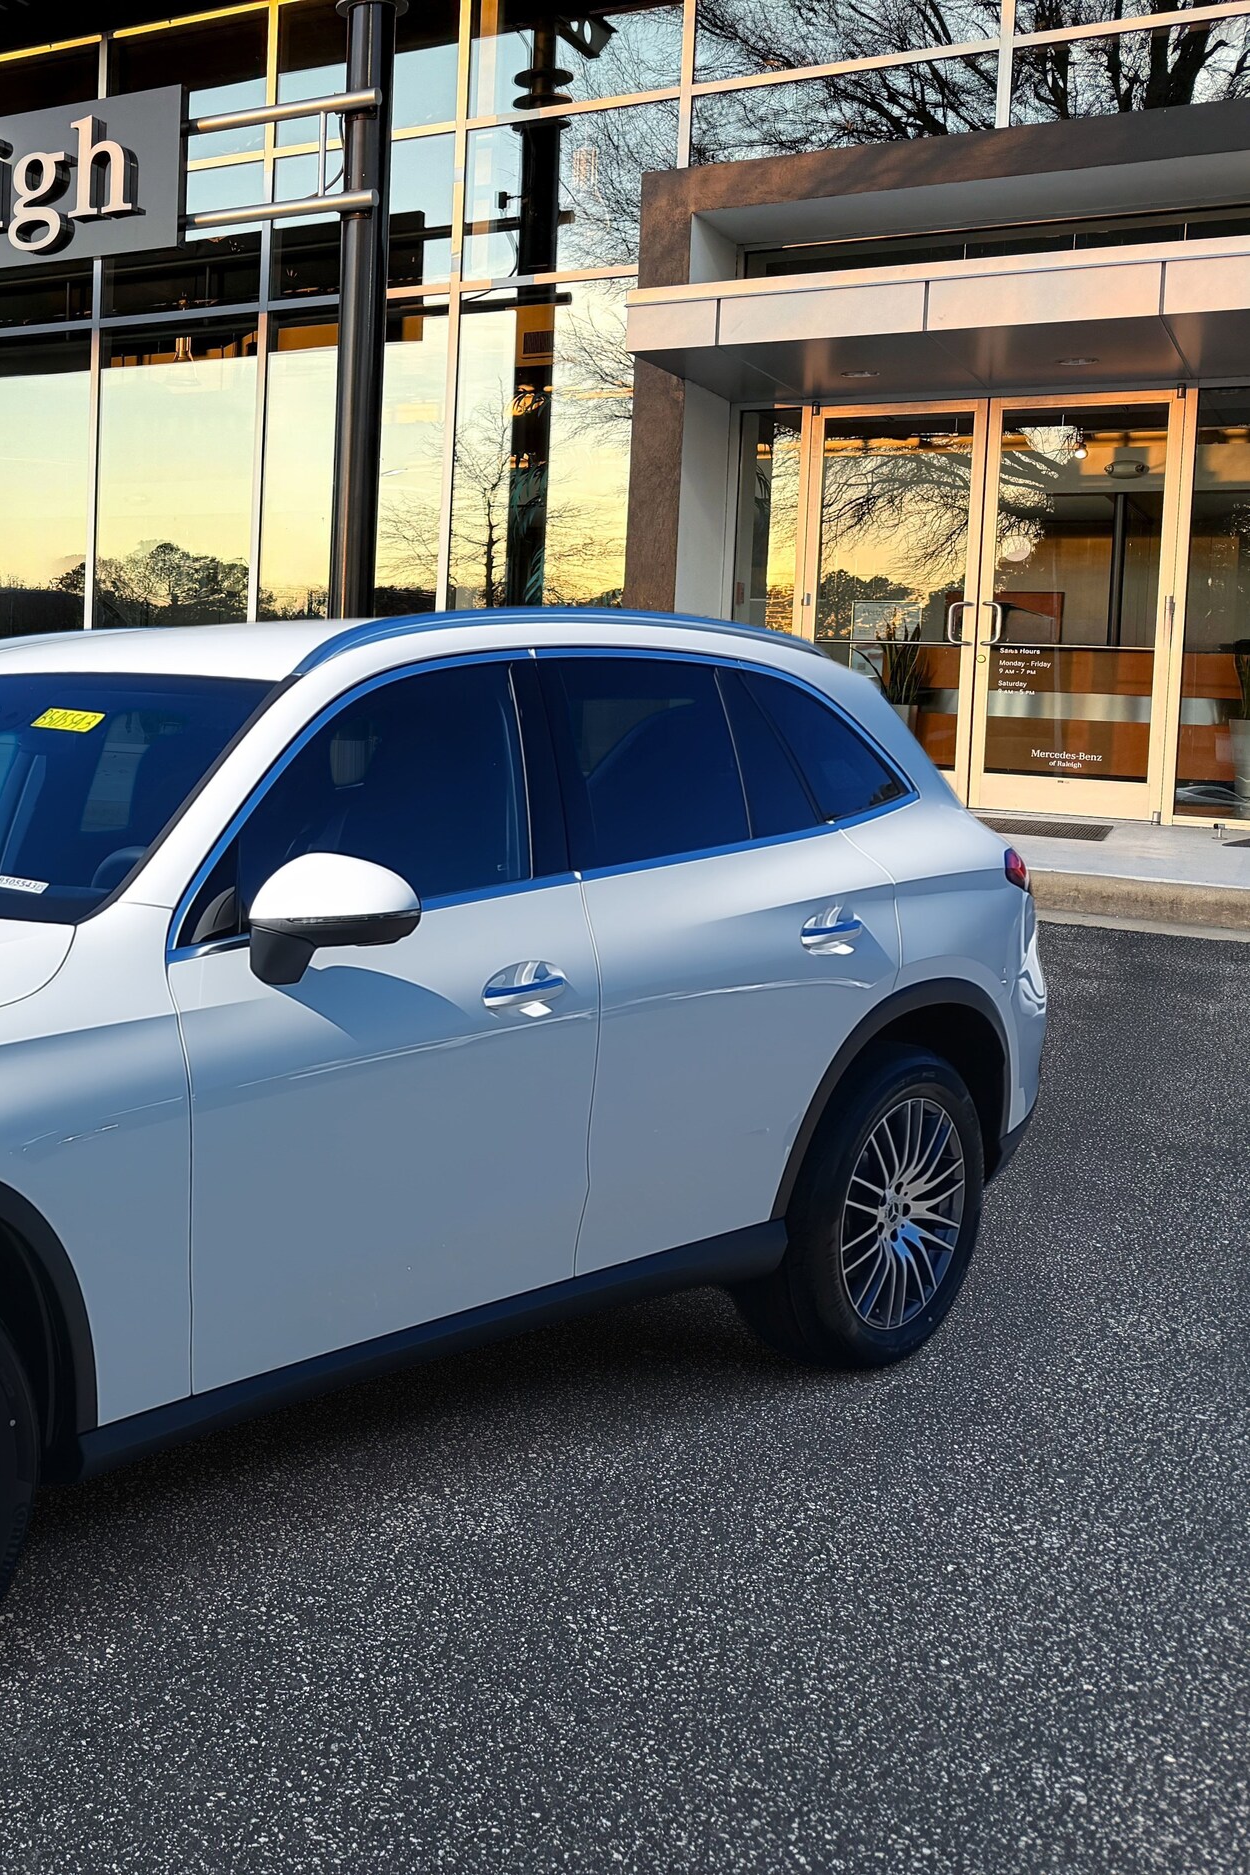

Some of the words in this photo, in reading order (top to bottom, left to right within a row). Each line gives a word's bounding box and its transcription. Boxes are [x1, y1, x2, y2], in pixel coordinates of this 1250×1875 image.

[999, 660, 1025, 668] Monday
[998, 680, 1027, 688] Saturday
[1031, 749, 1103, 762] Mercedes-Benz
[1057, 761, 1082, 769] Raleigh
